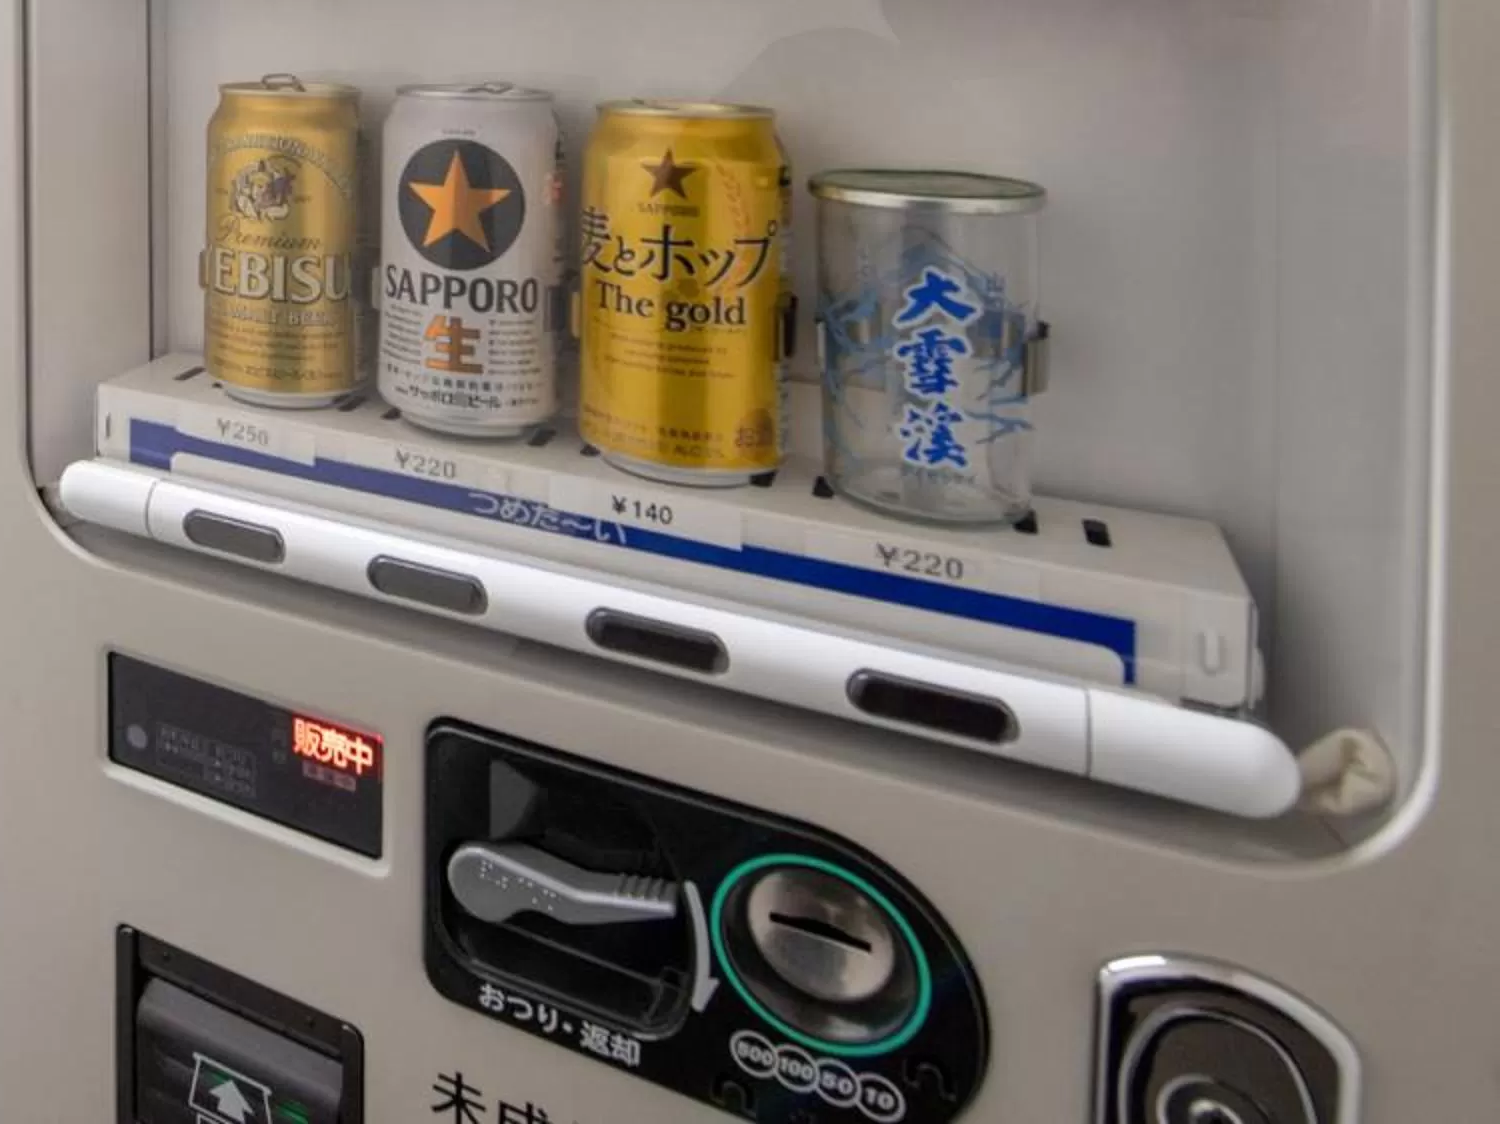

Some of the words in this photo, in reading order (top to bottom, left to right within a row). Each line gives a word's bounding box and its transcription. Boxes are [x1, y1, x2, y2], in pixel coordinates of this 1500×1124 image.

[581, 206, 778, 288] 麦とホップ
[204, 247, 351, 305] EBISU
[385, 263, 539, 314] SAPPORO
[595, 279, 655, 318] The
[664, 296, 747, 332] gold
[423, 314, 484, 375] 生
[217, 417, 269, 447] ¥250
[396, 448, 457, 479] ¥220
[611, 493, 673, 526] ¥140
[875, 542, 964, 578] ¥220
[293, 716, 374, 775] 販売中
[477, 982, 642, 1068] おつり・返却
[736, 1040, 774, 1066] 500
[779, 1056, 814, 1081] 100
[821, 1071, 854, 1095] 50
[864, 1087, 895, 1110] 10
